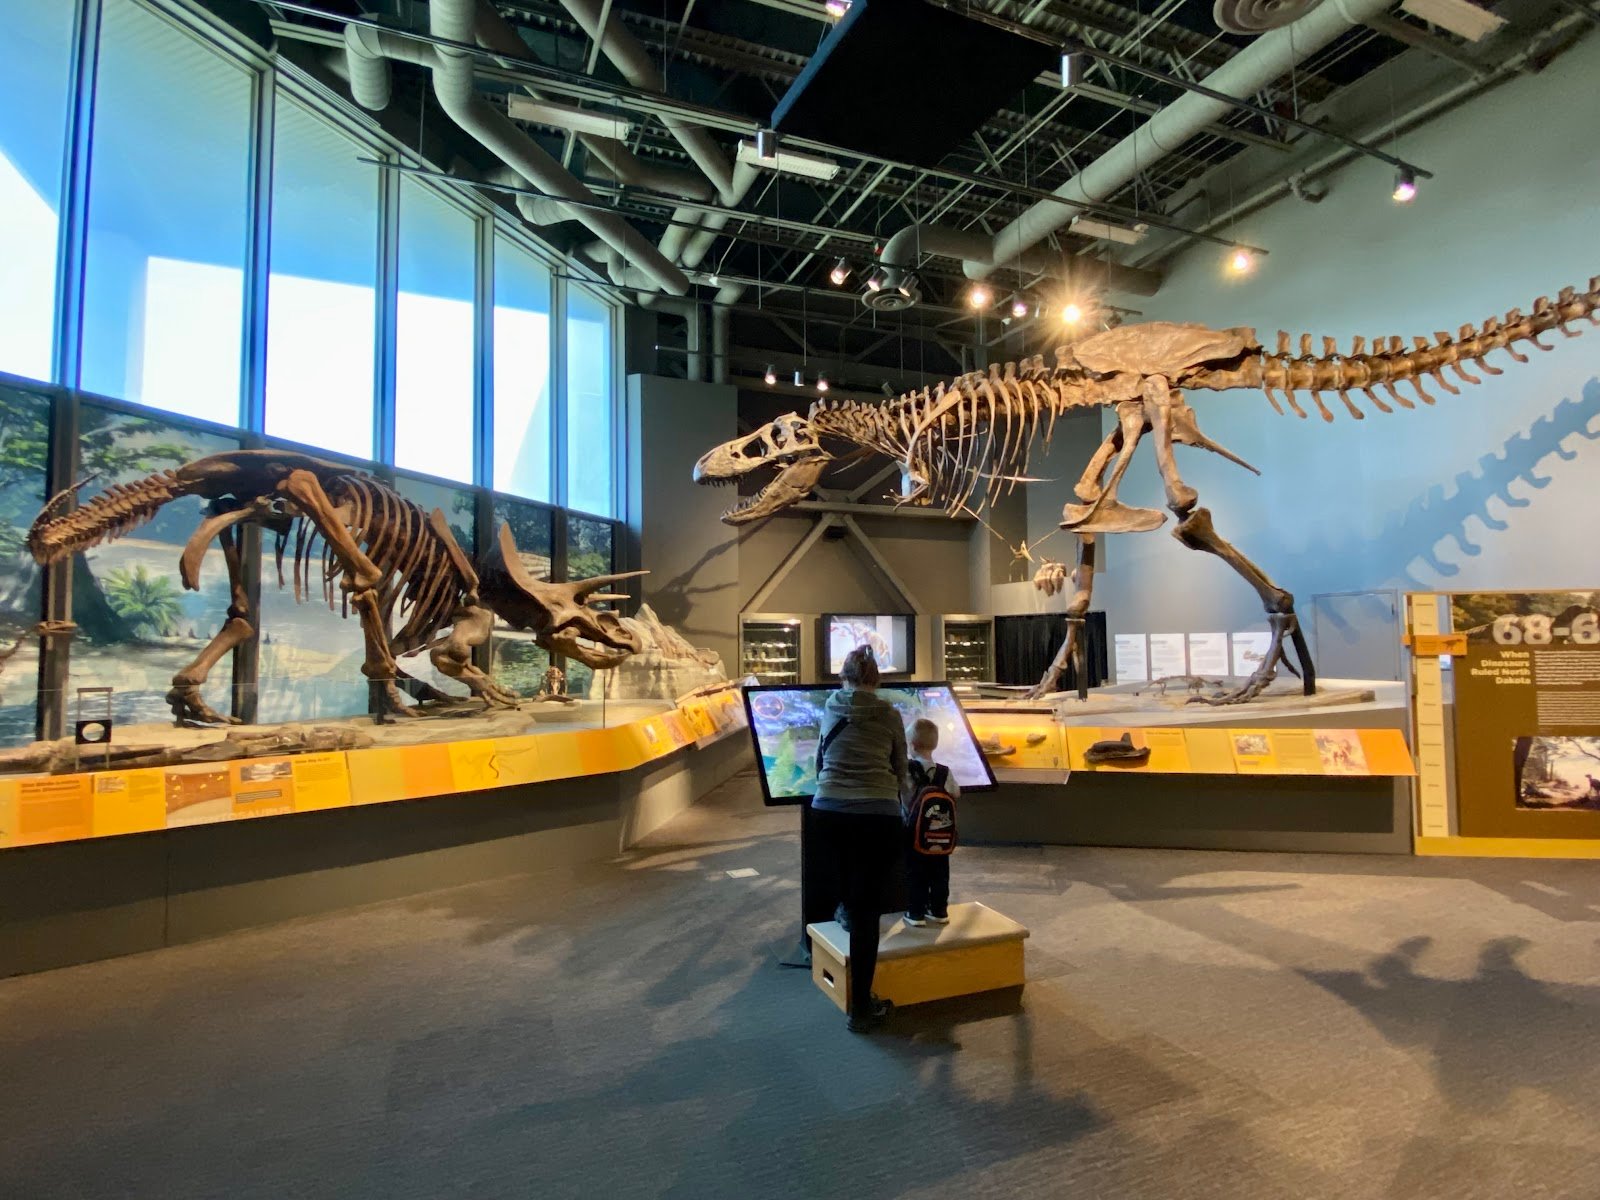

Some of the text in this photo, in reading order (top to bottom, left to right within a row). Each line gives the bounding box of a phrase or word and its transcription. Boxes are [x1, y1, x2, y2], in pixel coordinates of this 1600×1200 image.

[1481, 659, 1530, 668] Dinosaurs
[1471, 668, 1531, 676] Ruled North
[1495, 677, 1531, 685] Dakota
